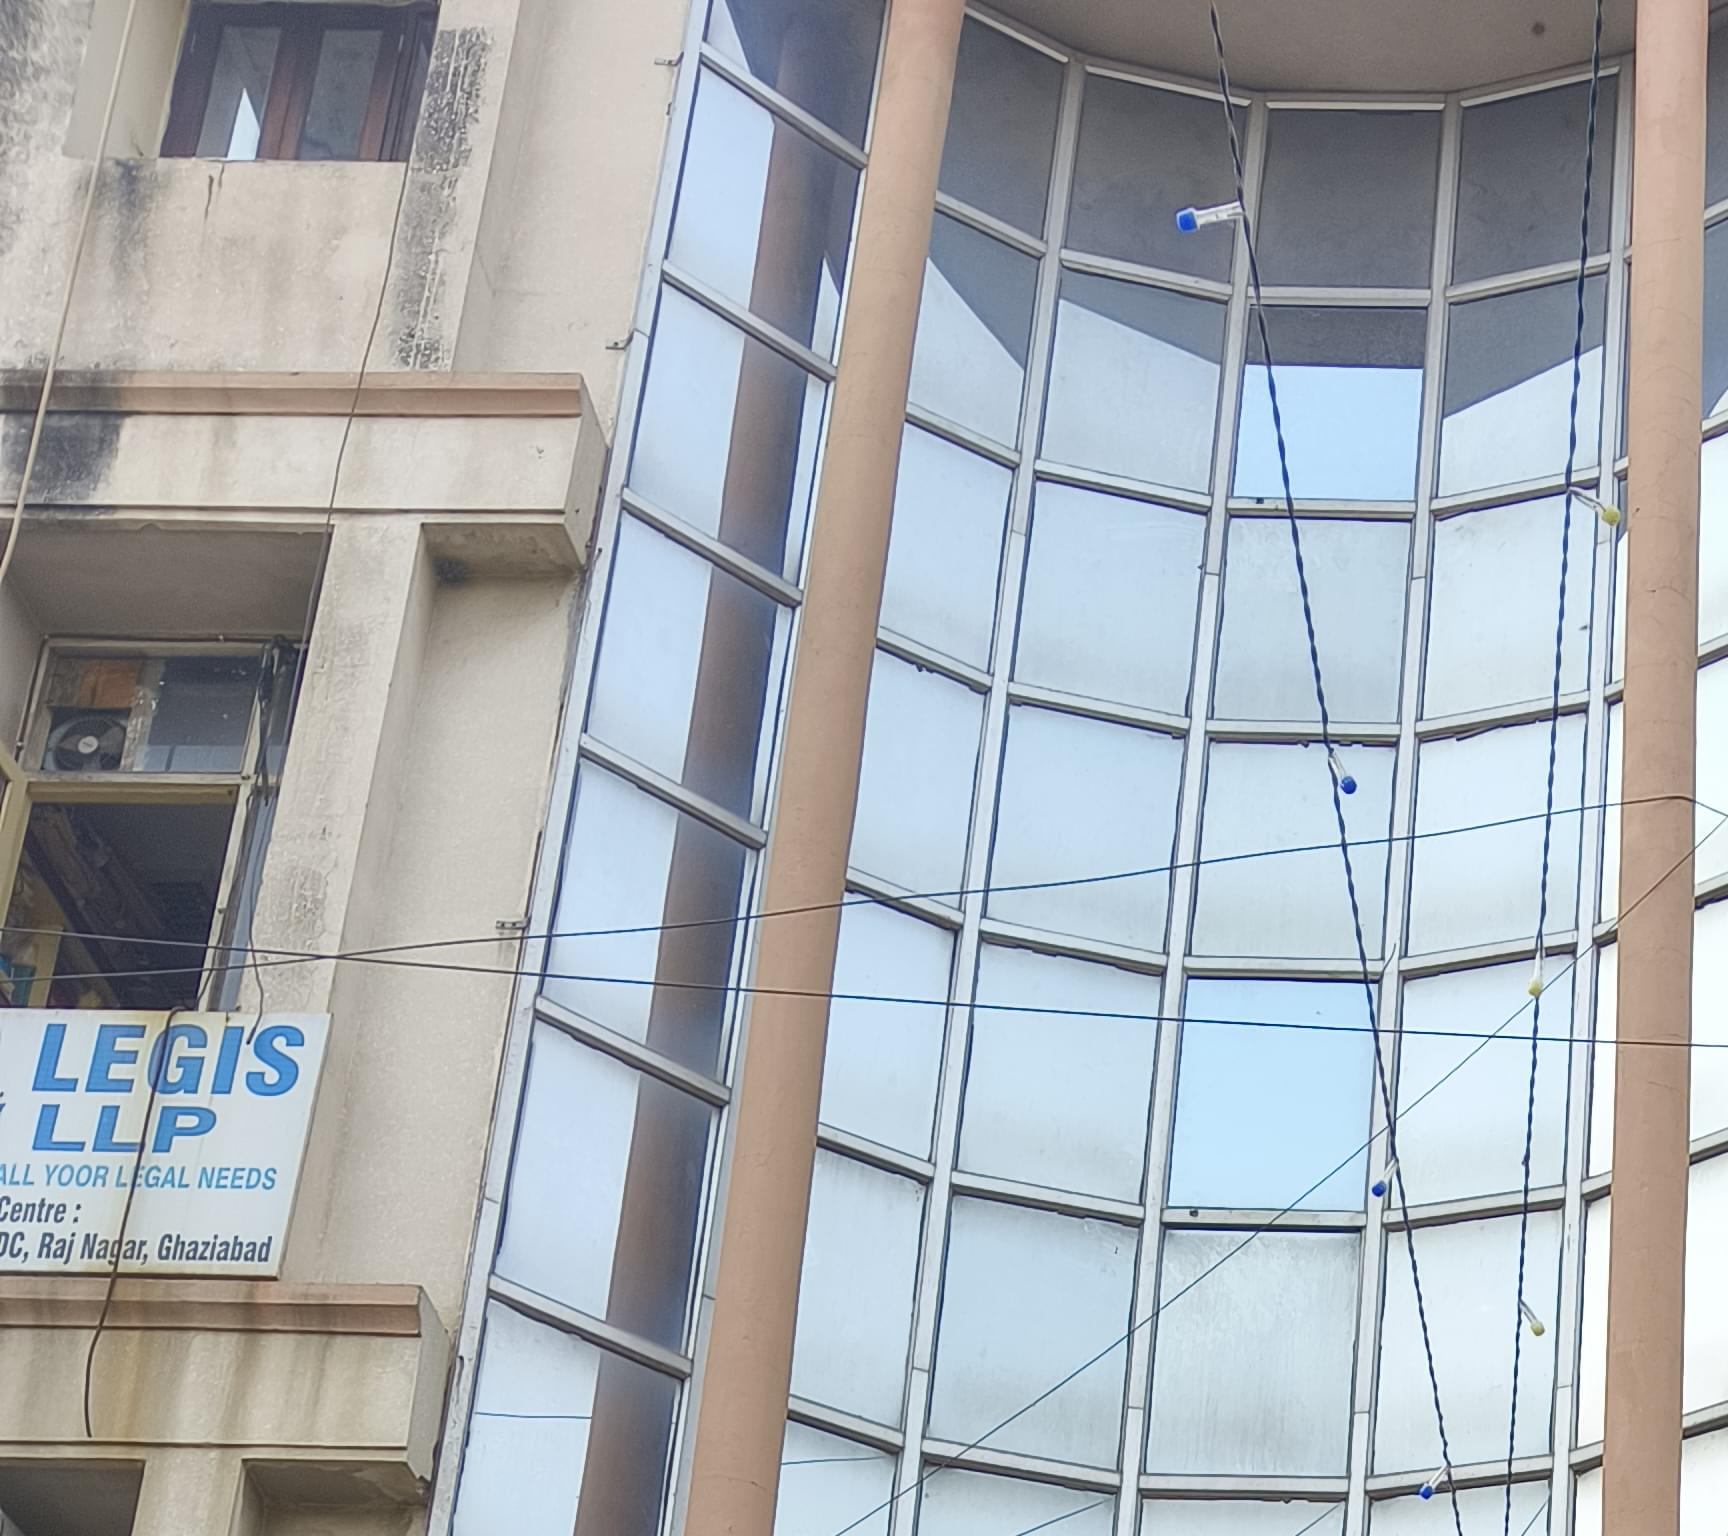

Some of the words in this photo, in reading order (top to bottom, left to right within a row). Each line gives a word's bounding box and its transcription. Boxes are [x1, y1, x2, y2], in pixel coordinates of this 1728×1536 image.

[32, 1023, 304, 1096] LEGIS
[32, 1103, 217, 1153] LLP
[115, 1165, 190, 1189] LEGAL
[197, 1167, 277, 1190] NEEDS
[37, 1231, 76, 1265] Raj
[80, 1233, 148, 1266] Nagar,
[158, 1233, 272, 1263] Ghaziabad
